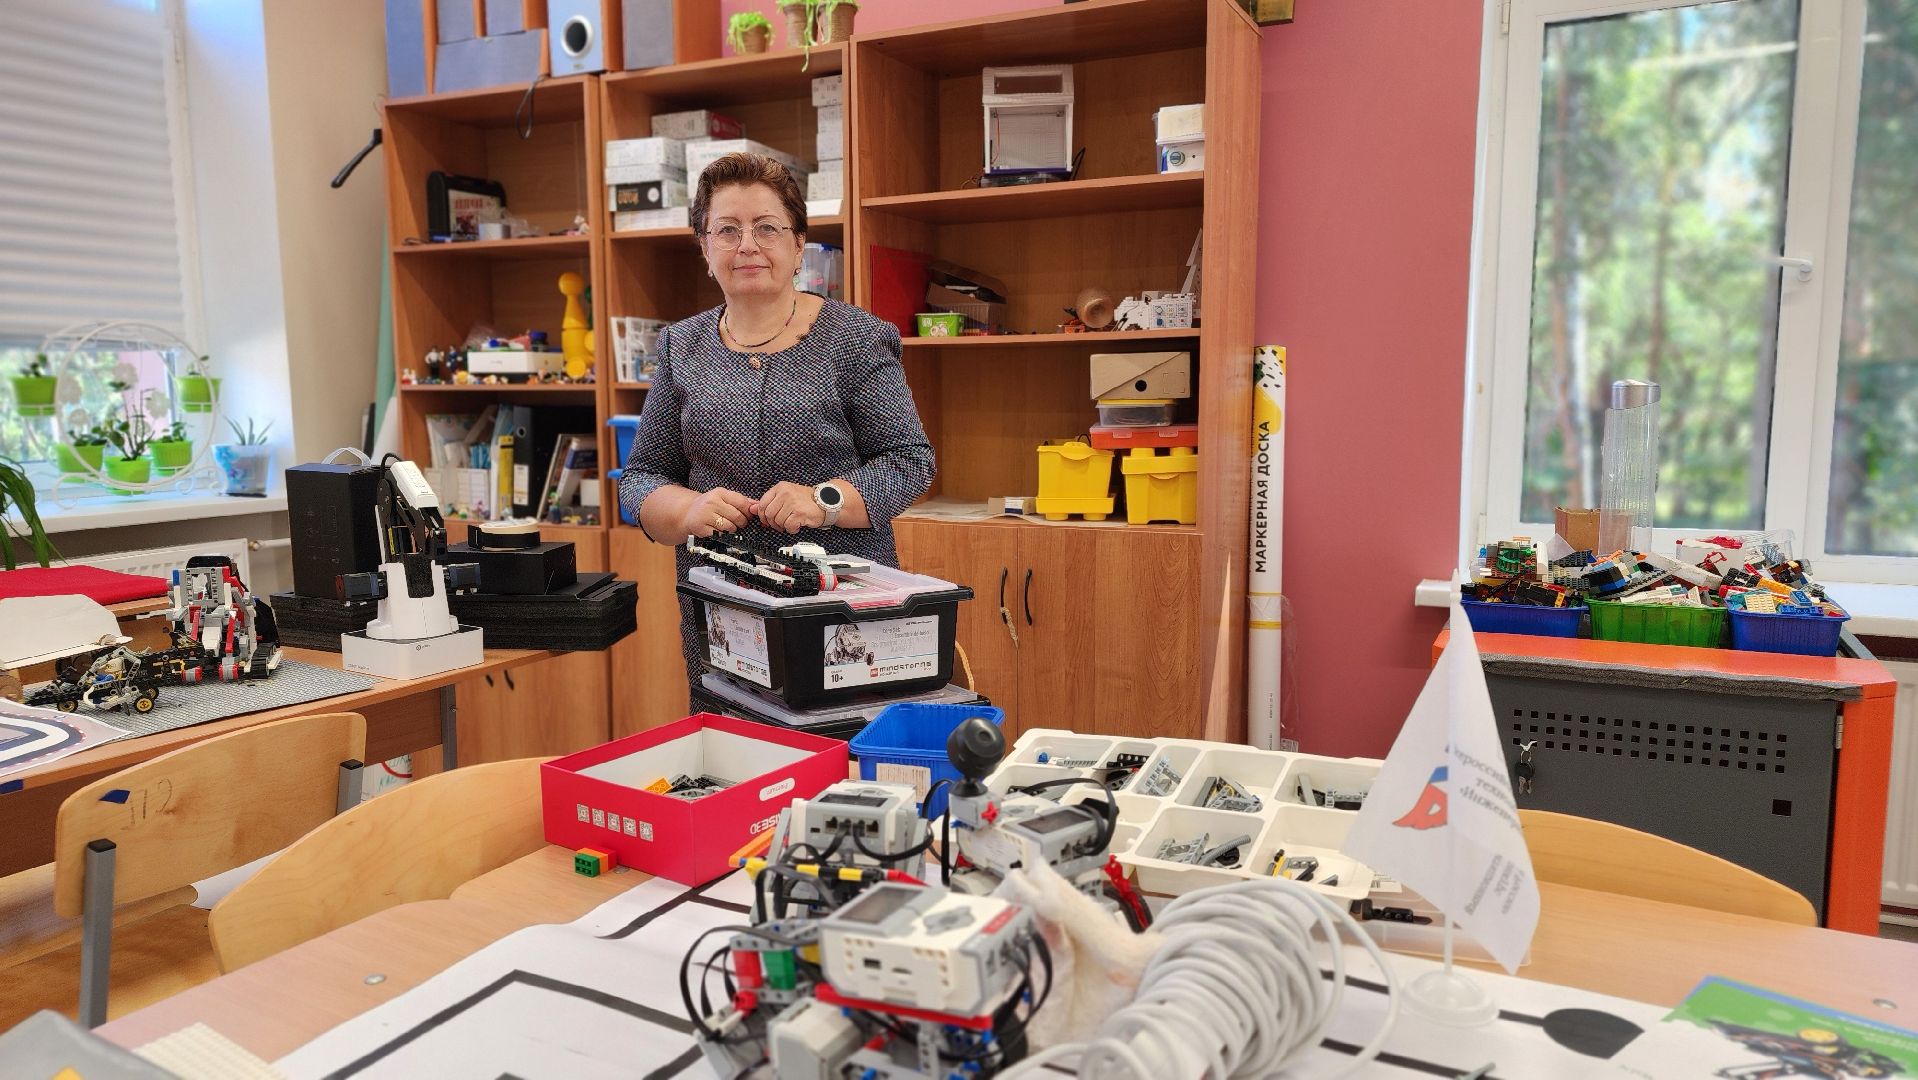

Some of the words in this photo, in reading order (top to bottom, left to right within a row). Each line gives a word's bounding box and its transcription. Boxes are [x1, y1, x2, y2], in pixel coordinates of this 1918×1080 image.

[1258, 421, 1270, 476] ДОСКА
[1255, 480, 1269, 573] МАРКЕРНАЯ
[831, 674, 844, 684] 10+
